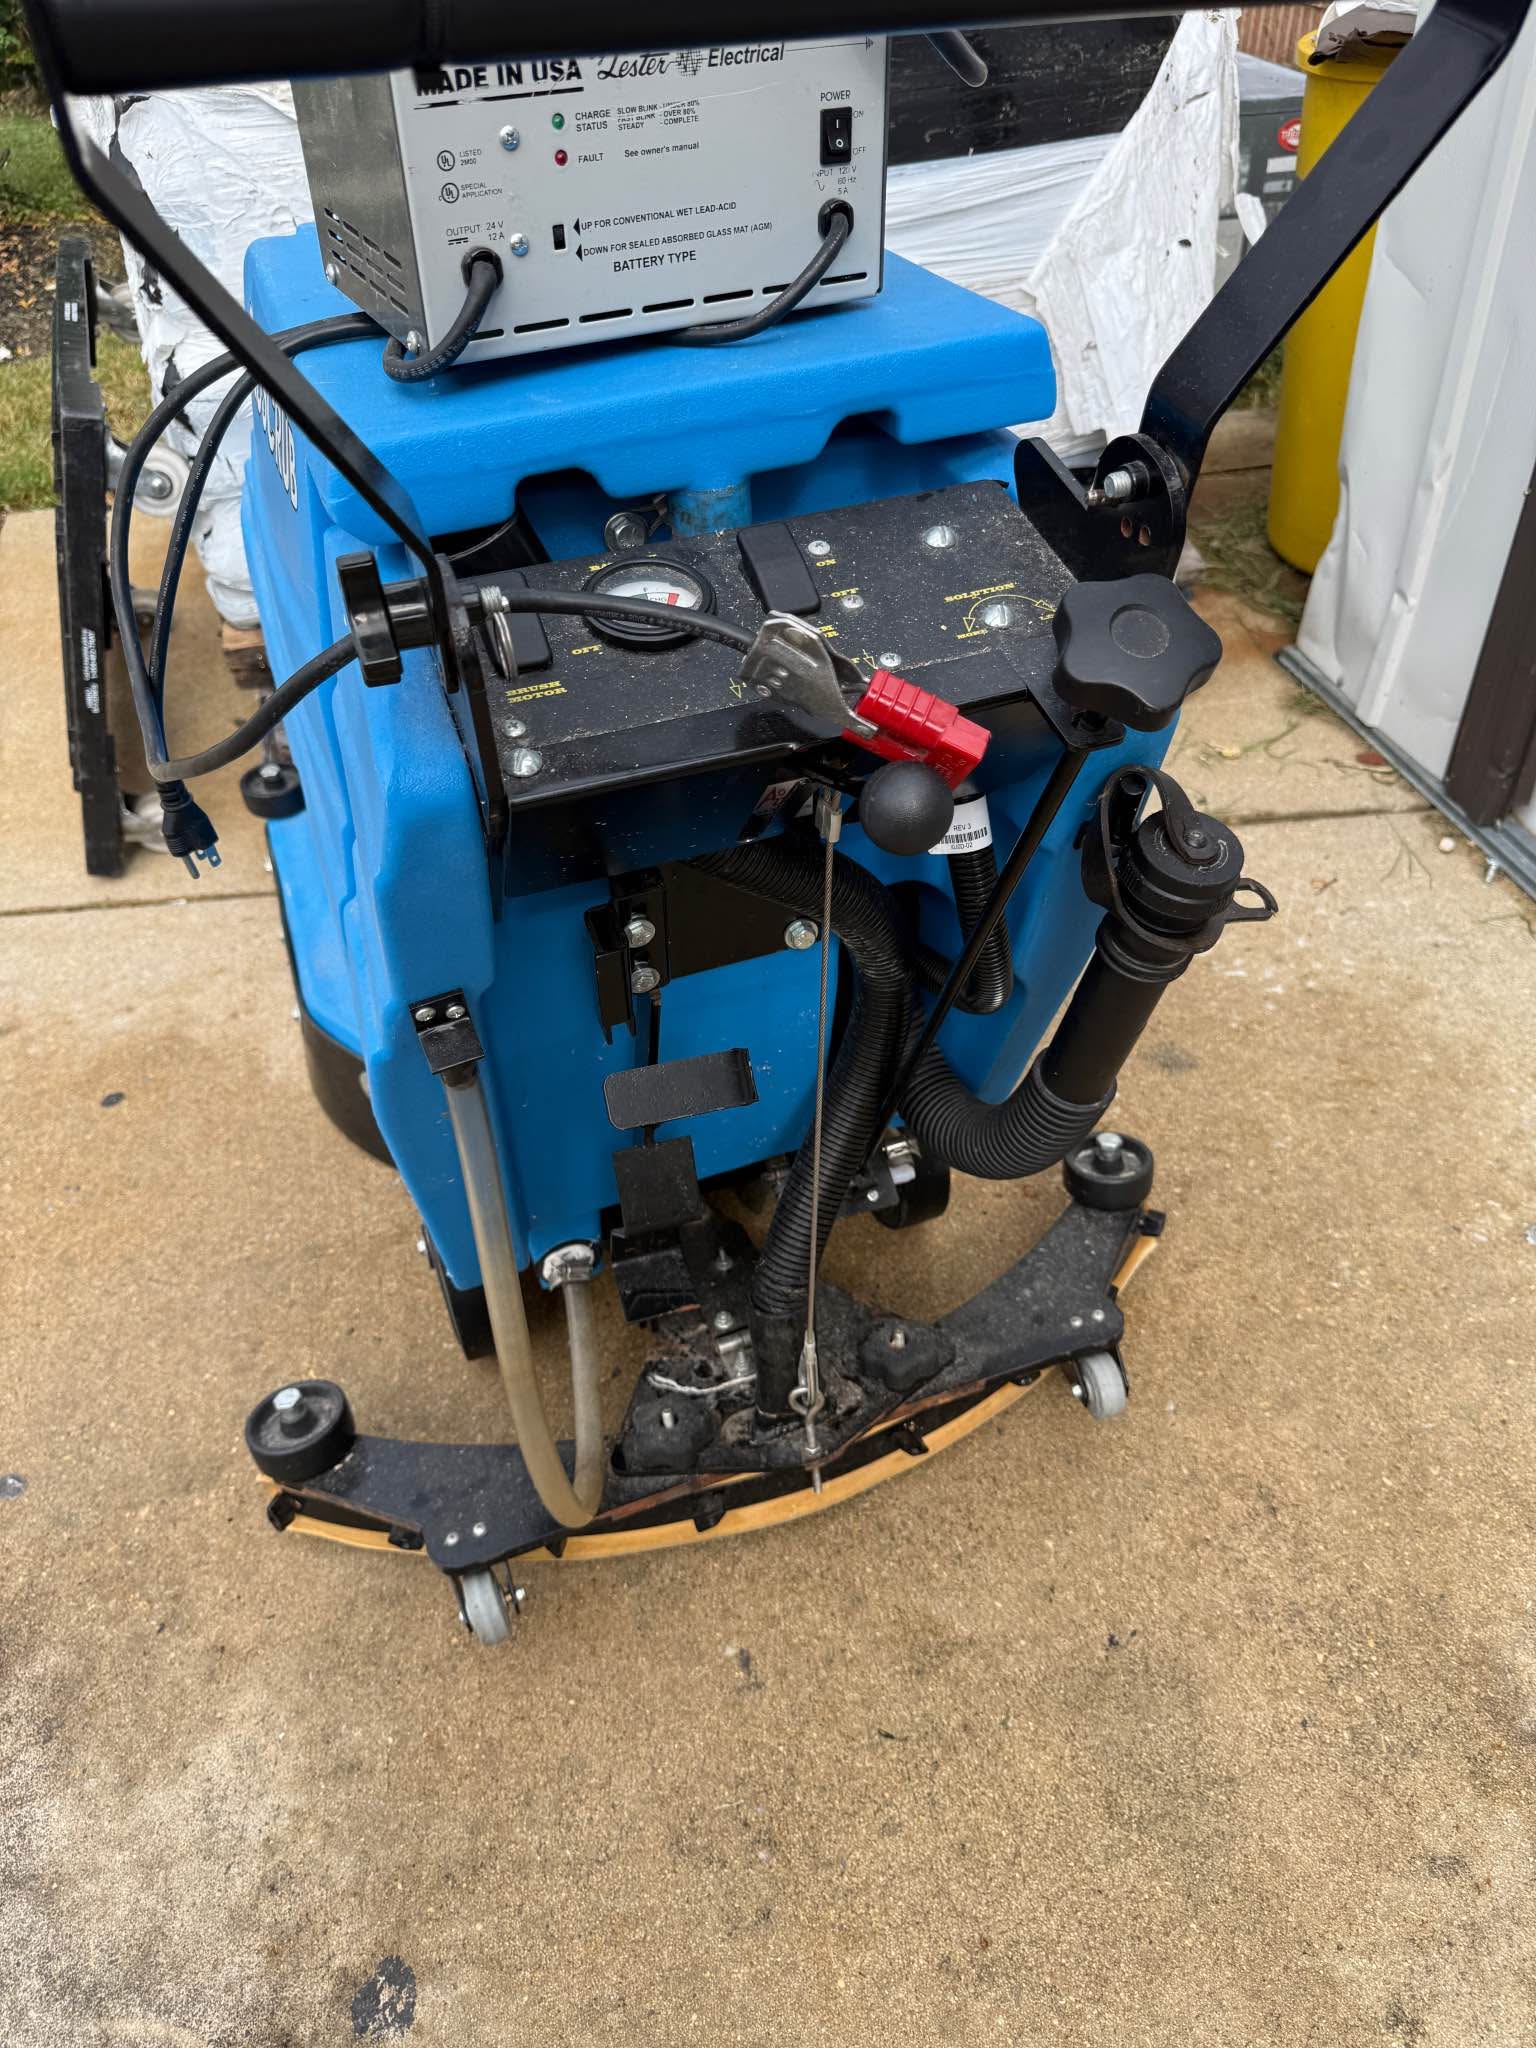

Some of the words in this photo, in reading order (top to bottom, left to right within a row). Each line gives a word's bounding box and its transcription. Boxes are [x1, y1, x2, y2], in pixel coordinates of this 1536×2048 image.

[597, 51, 672, 80] Lester
[708, 41, 786, 67] Electrical
[416, 65, 489, 97] ADE
[497, 62, 523, 86] IN
[531, 57, 582, 82] USA
[820, 90, 851, 101] POWER
[575, 108, 611, 121] CHARGE
[617, 107, 636, 116] SLOW
[638, 104, 658, 113] BLINK
[664, 110, 681, 118] OVER
[576, 120, 608, 132] STATUS
[618, 122, 645, 131] STEADY
[459, 149, 482, 158] LISTED
[624, 149, 639, 158] See
[640, 146, 670, 156] owner's
[672, 141, 699, 152] manual
[578, 152, 605, 164] FAULT
[460, 182, 487, 191] SPECIAL
[461, 188, 503, 199] APPLICATION
[581, 221, 592, 230] UP
[594, 219, 611, 228] FOR
[613, 210, 675, 226] CONVENTIONAL
[676, 207, 693, 217] WET
[695, 201, 736, 215] LEAD-ACID
[486, 221, 496, 231] 24
[498, 220, 504, 229] V
[488, 232, 498, 241] 12
[499, 231, 505, 240] A
[583, 246, 608, 257] DOWN
[610, 242, 627, 252] FOR
[628, 237, 660, 250] SEALED
[661, 231, 705, 245] ABSORBED
[706, 227, 732, 238] GLASS
[733, 224, 748, 235] MAT
[750, 221, 773, 234] (AGM)
[613, 254, 665, 273] BATTERY
[667, 250, 697, 264] TYPE
[831, 587, 859, 597] OFF
[943, 582, 1016, 603] SOLUTION
[957, 628, 988, 639] MORE
[571, 644, 602, 655] OFF
[505, 681, 562, 697] BRUSH
[508, 687, 568, 704] MOTOR
[953, 823, 966, 832] REV
